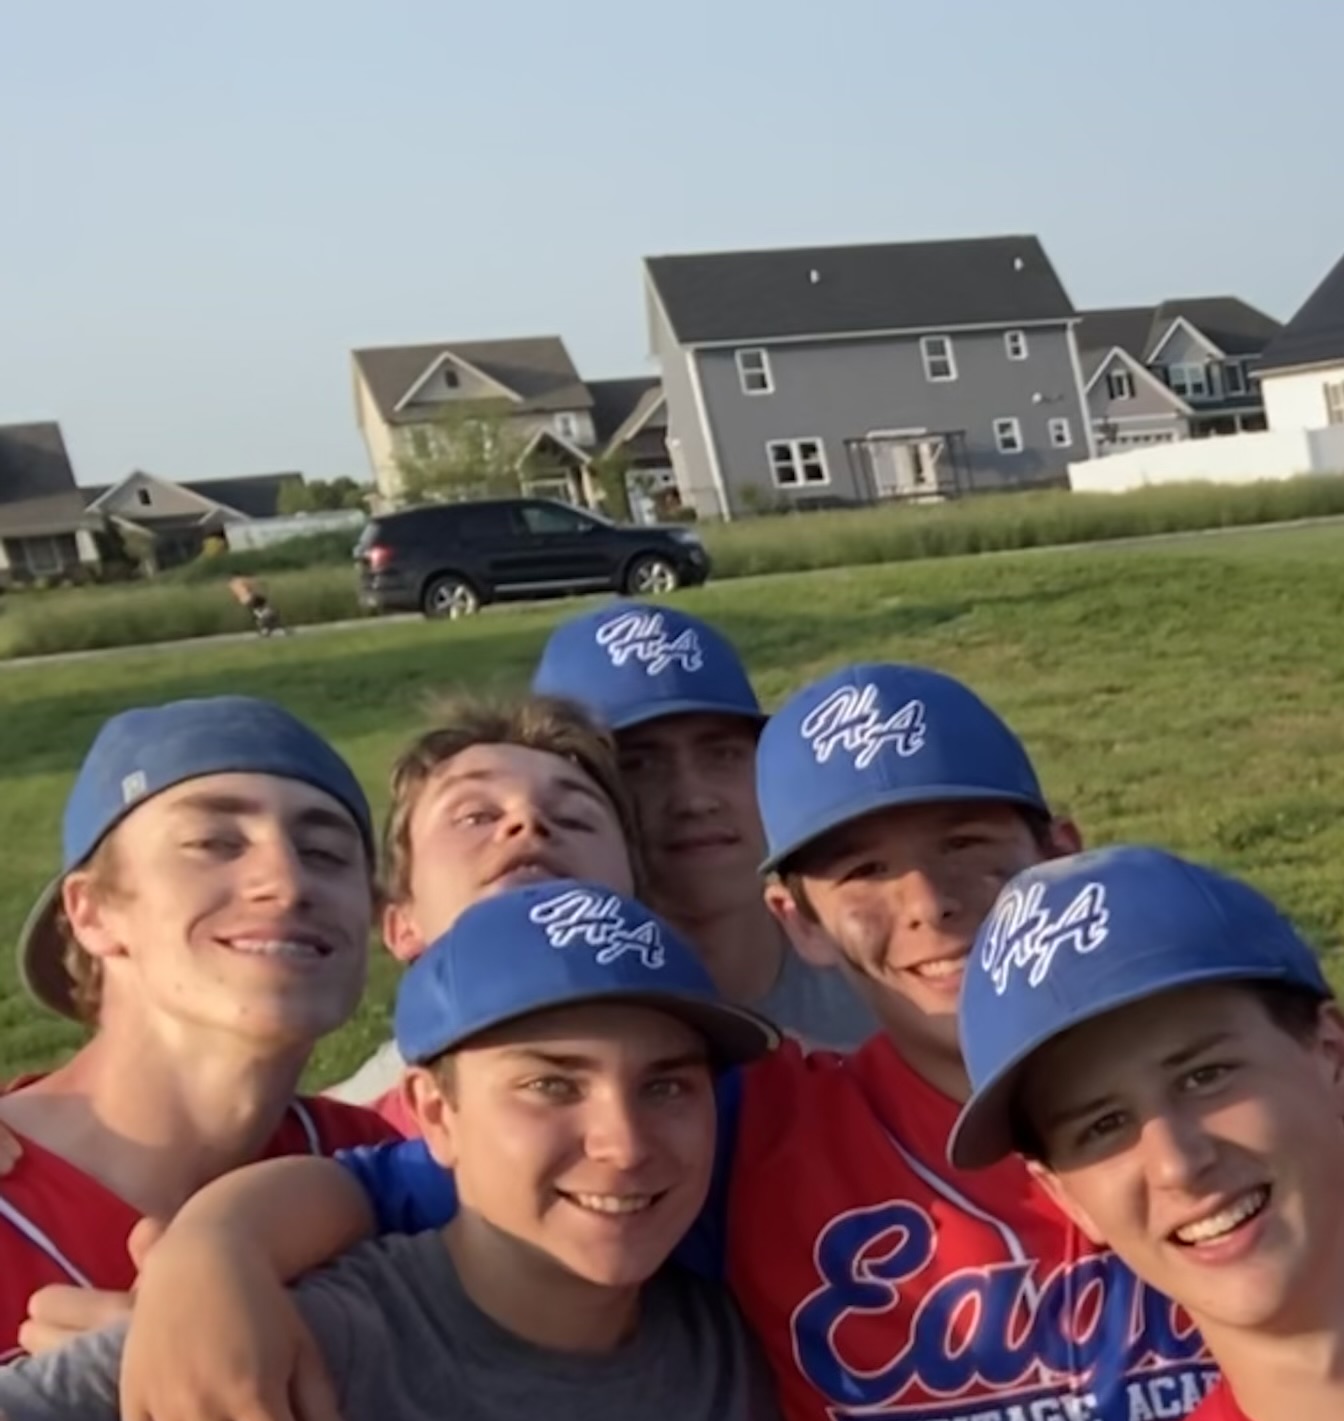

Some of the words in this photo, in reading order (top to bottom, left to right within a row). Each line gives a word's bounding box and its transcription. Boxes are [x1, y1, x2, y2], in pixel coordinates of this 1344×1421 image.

[596, 610, 703, 676] HA
[802, 683, 926, 769] HA
[529, 889, 665, 970] HA
[981, 881, 1110, 994] HA
